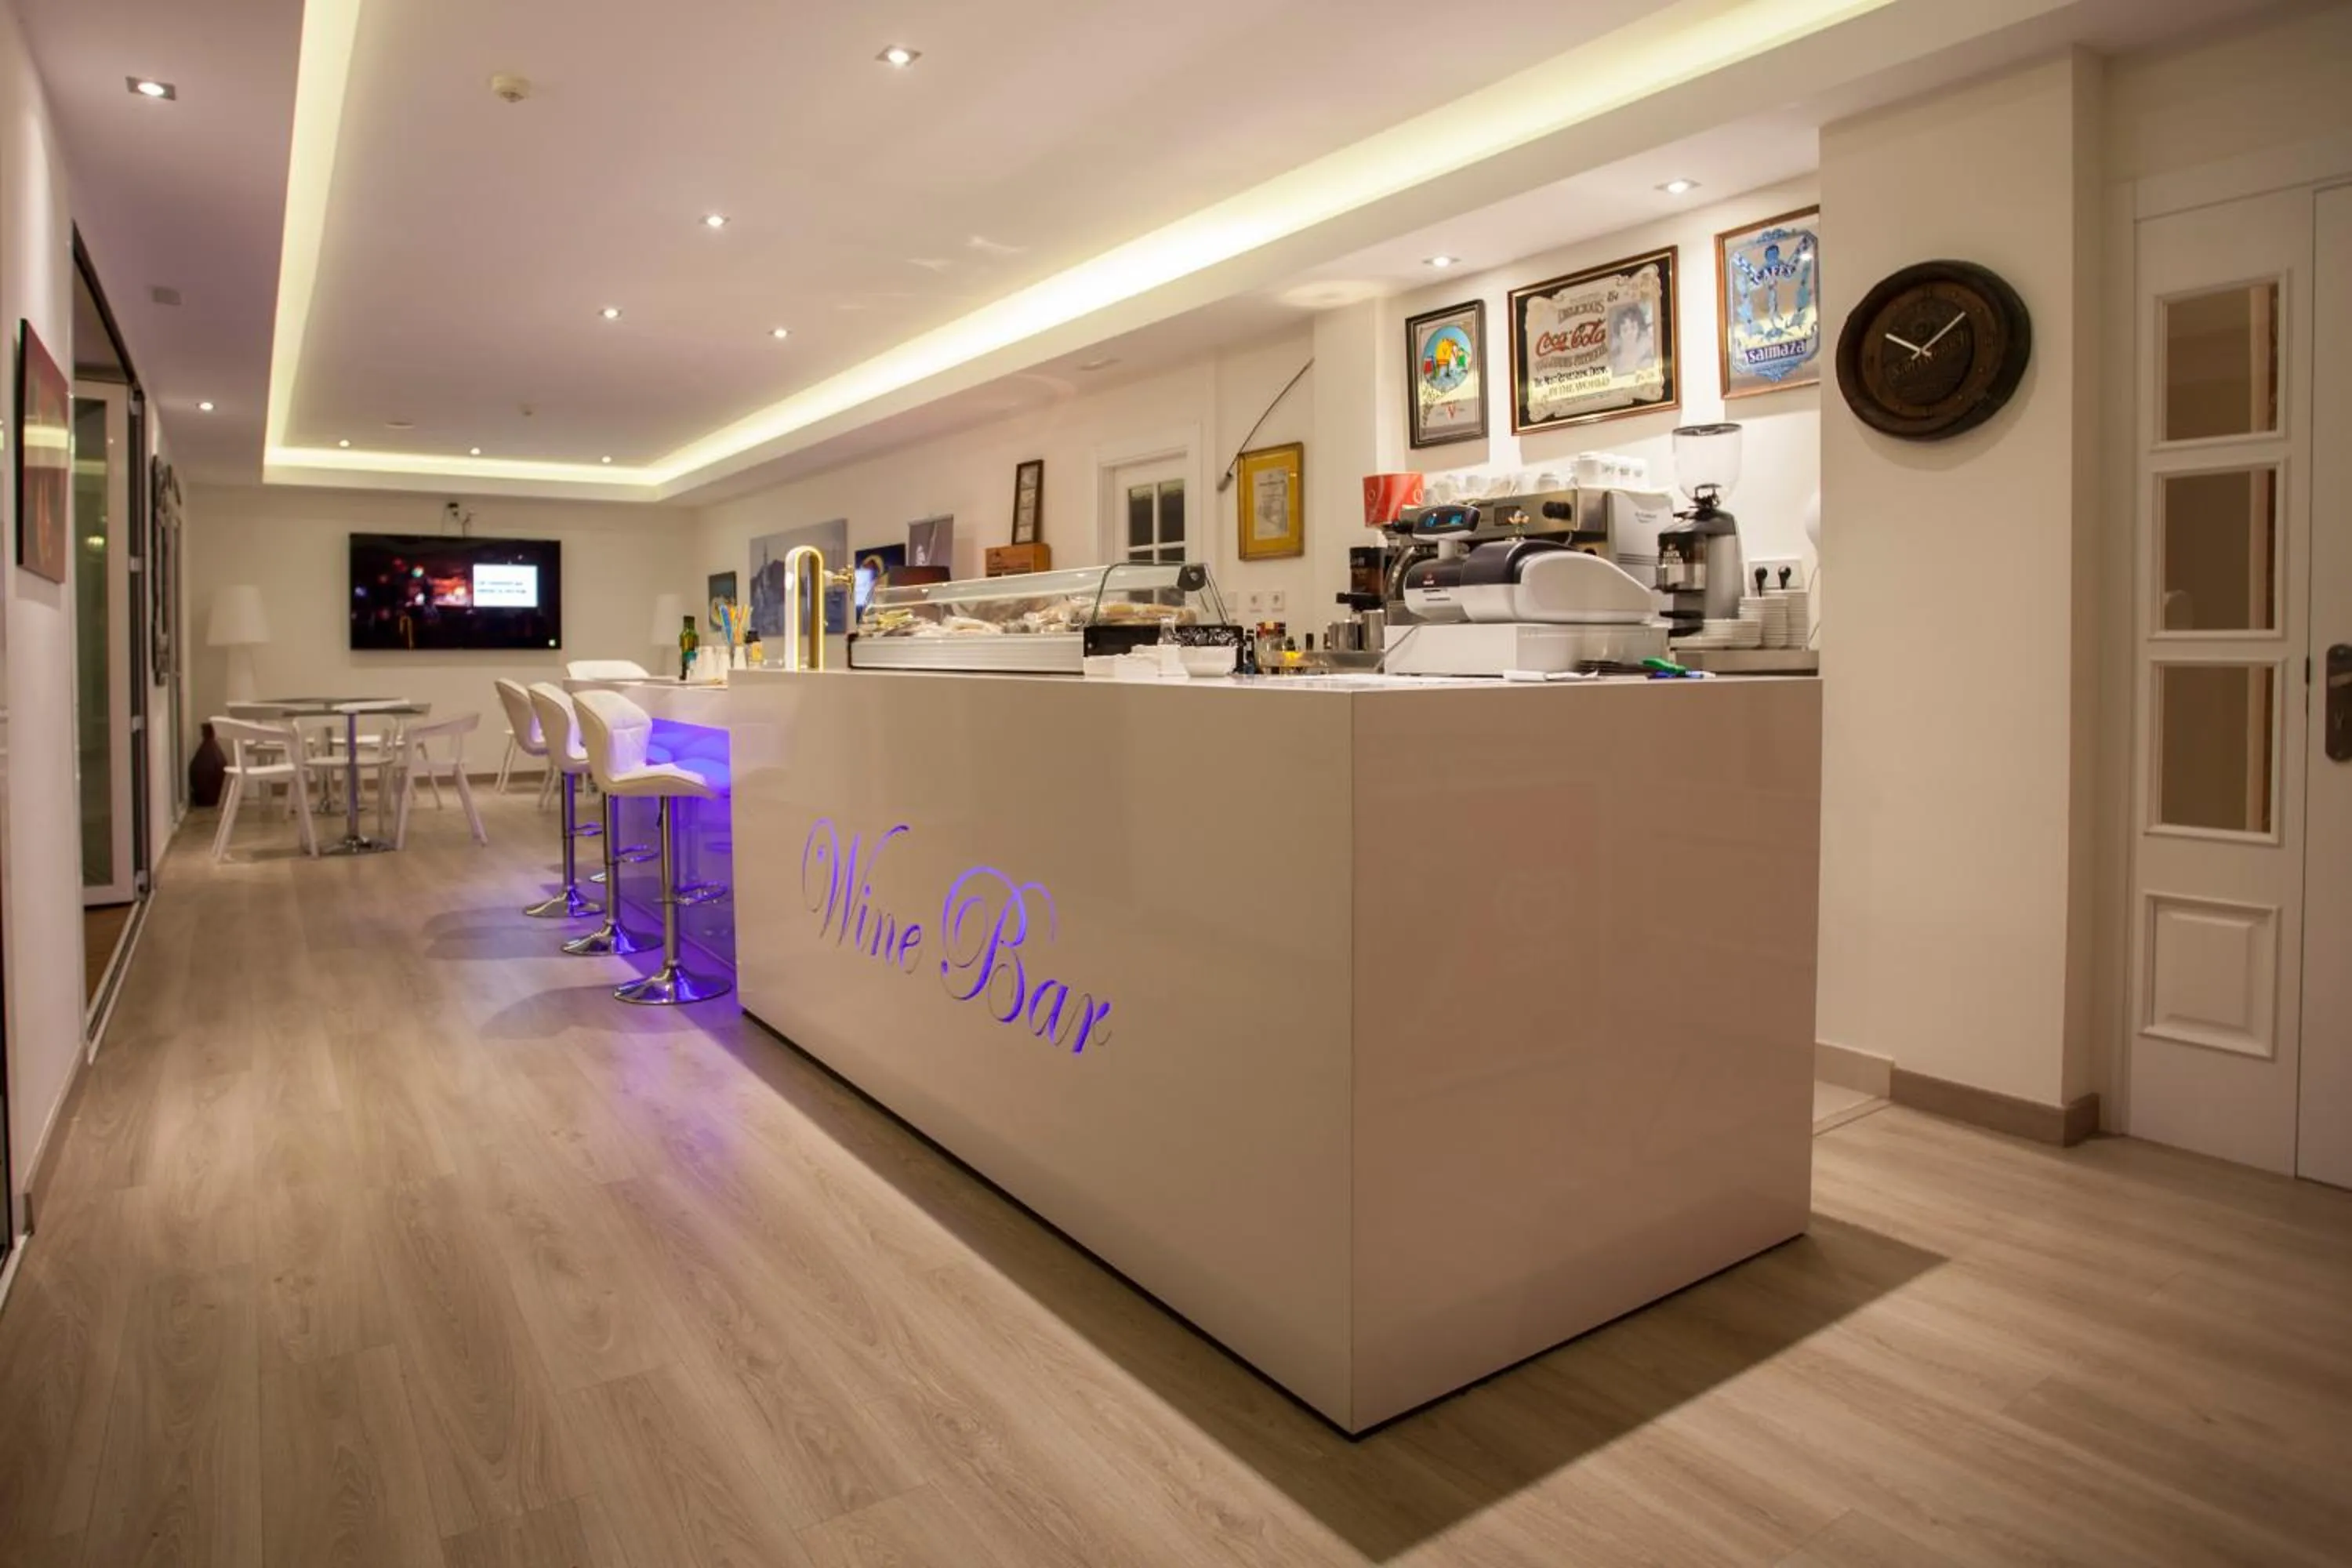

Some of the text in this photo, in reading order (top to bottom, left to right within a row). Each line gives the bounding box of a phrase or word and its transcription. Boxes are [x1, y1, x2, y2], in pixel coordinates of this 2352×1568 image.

[1536, 318, 1606, 357] Coca-Cola
[802, 816, 1112, 1054] Wine Bar
